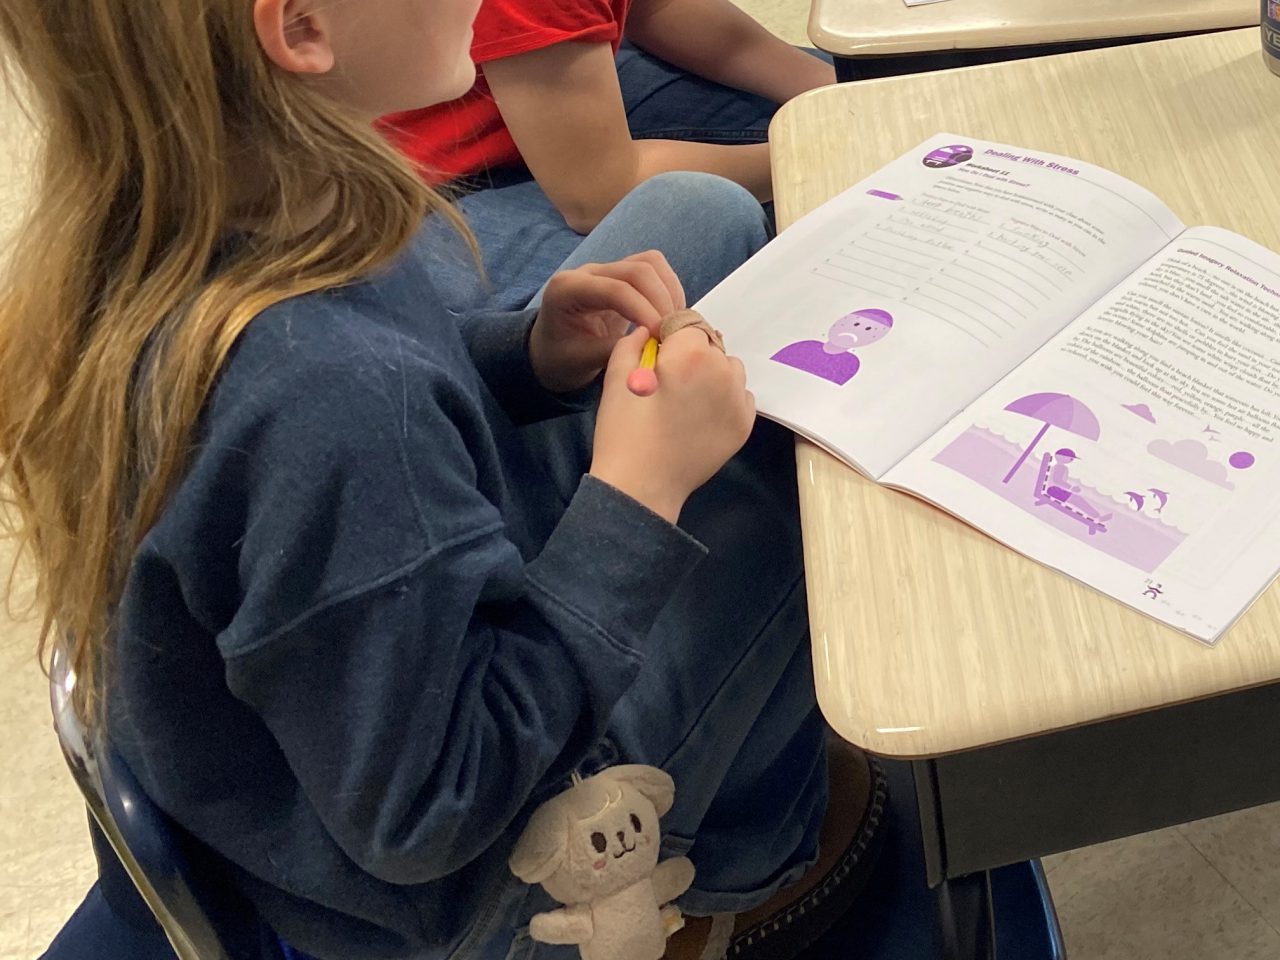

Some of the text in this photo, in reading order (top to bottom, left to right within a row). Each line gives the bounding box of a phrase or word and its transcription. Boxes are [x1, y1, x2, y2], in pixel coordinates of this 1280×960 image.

[984, 149, 1079, 175] Dealing With Stress
